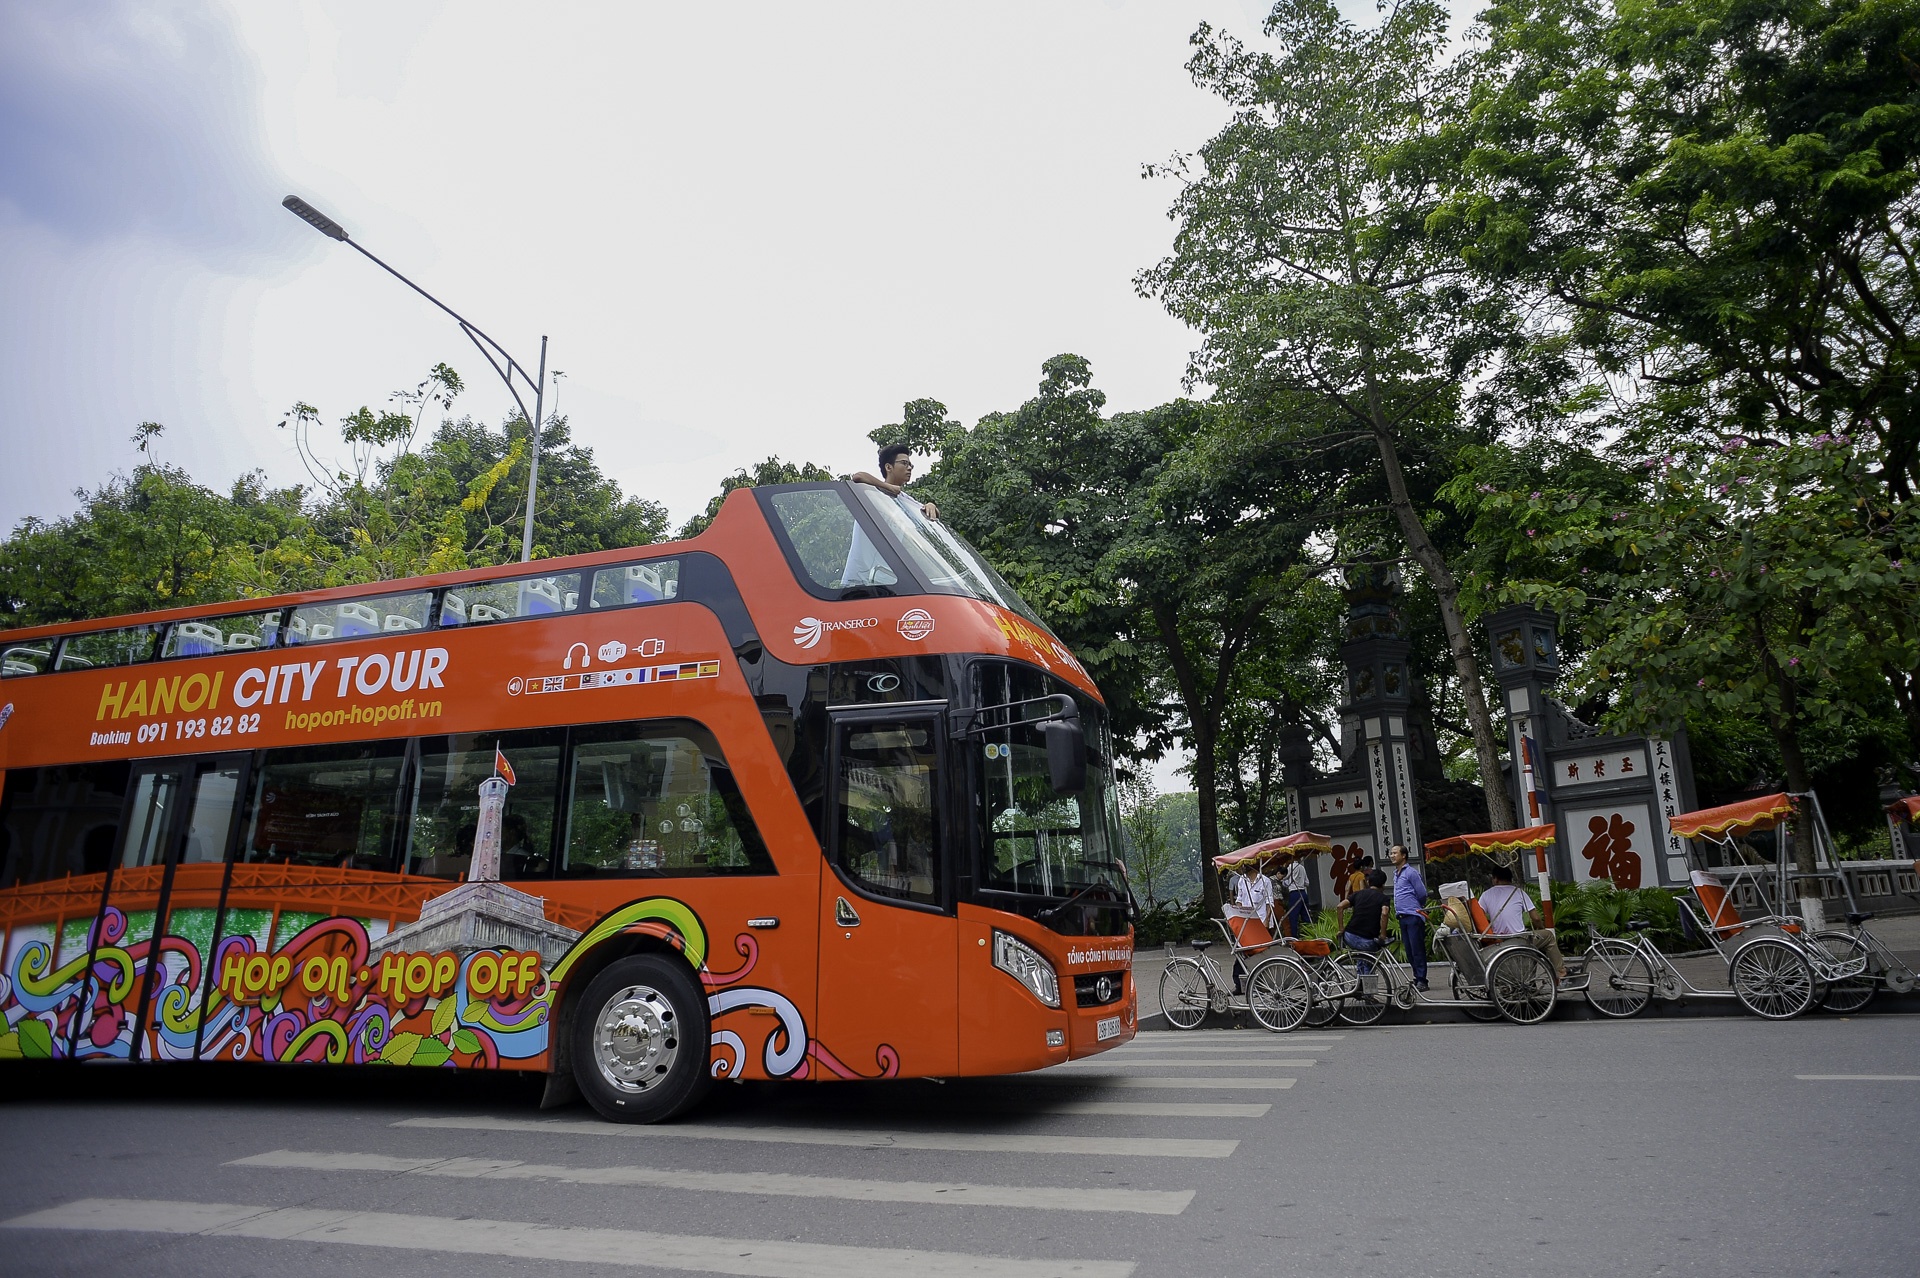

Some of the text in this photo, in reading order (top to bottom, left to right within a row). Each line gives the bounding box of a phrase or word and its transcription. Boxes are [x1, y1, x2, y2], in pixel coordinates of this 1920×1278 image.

[821, 617, 878, 632] TRANSERCO
[96, 647, 449, 720] HANOI CITY TOUR
[89, 712, 261, 746] Booking 091 193 82 82
[284, 699, 443, 732] hopon-hopoff.vn
[1067, 945, 1085, 965] TỔNG
[1085, 947, 1101, 963] CÔNG
[221, 956, 291, 1001] HOP
[380, 956, 456, 1003] HOP
[470, 956, 537, 994] OFF
